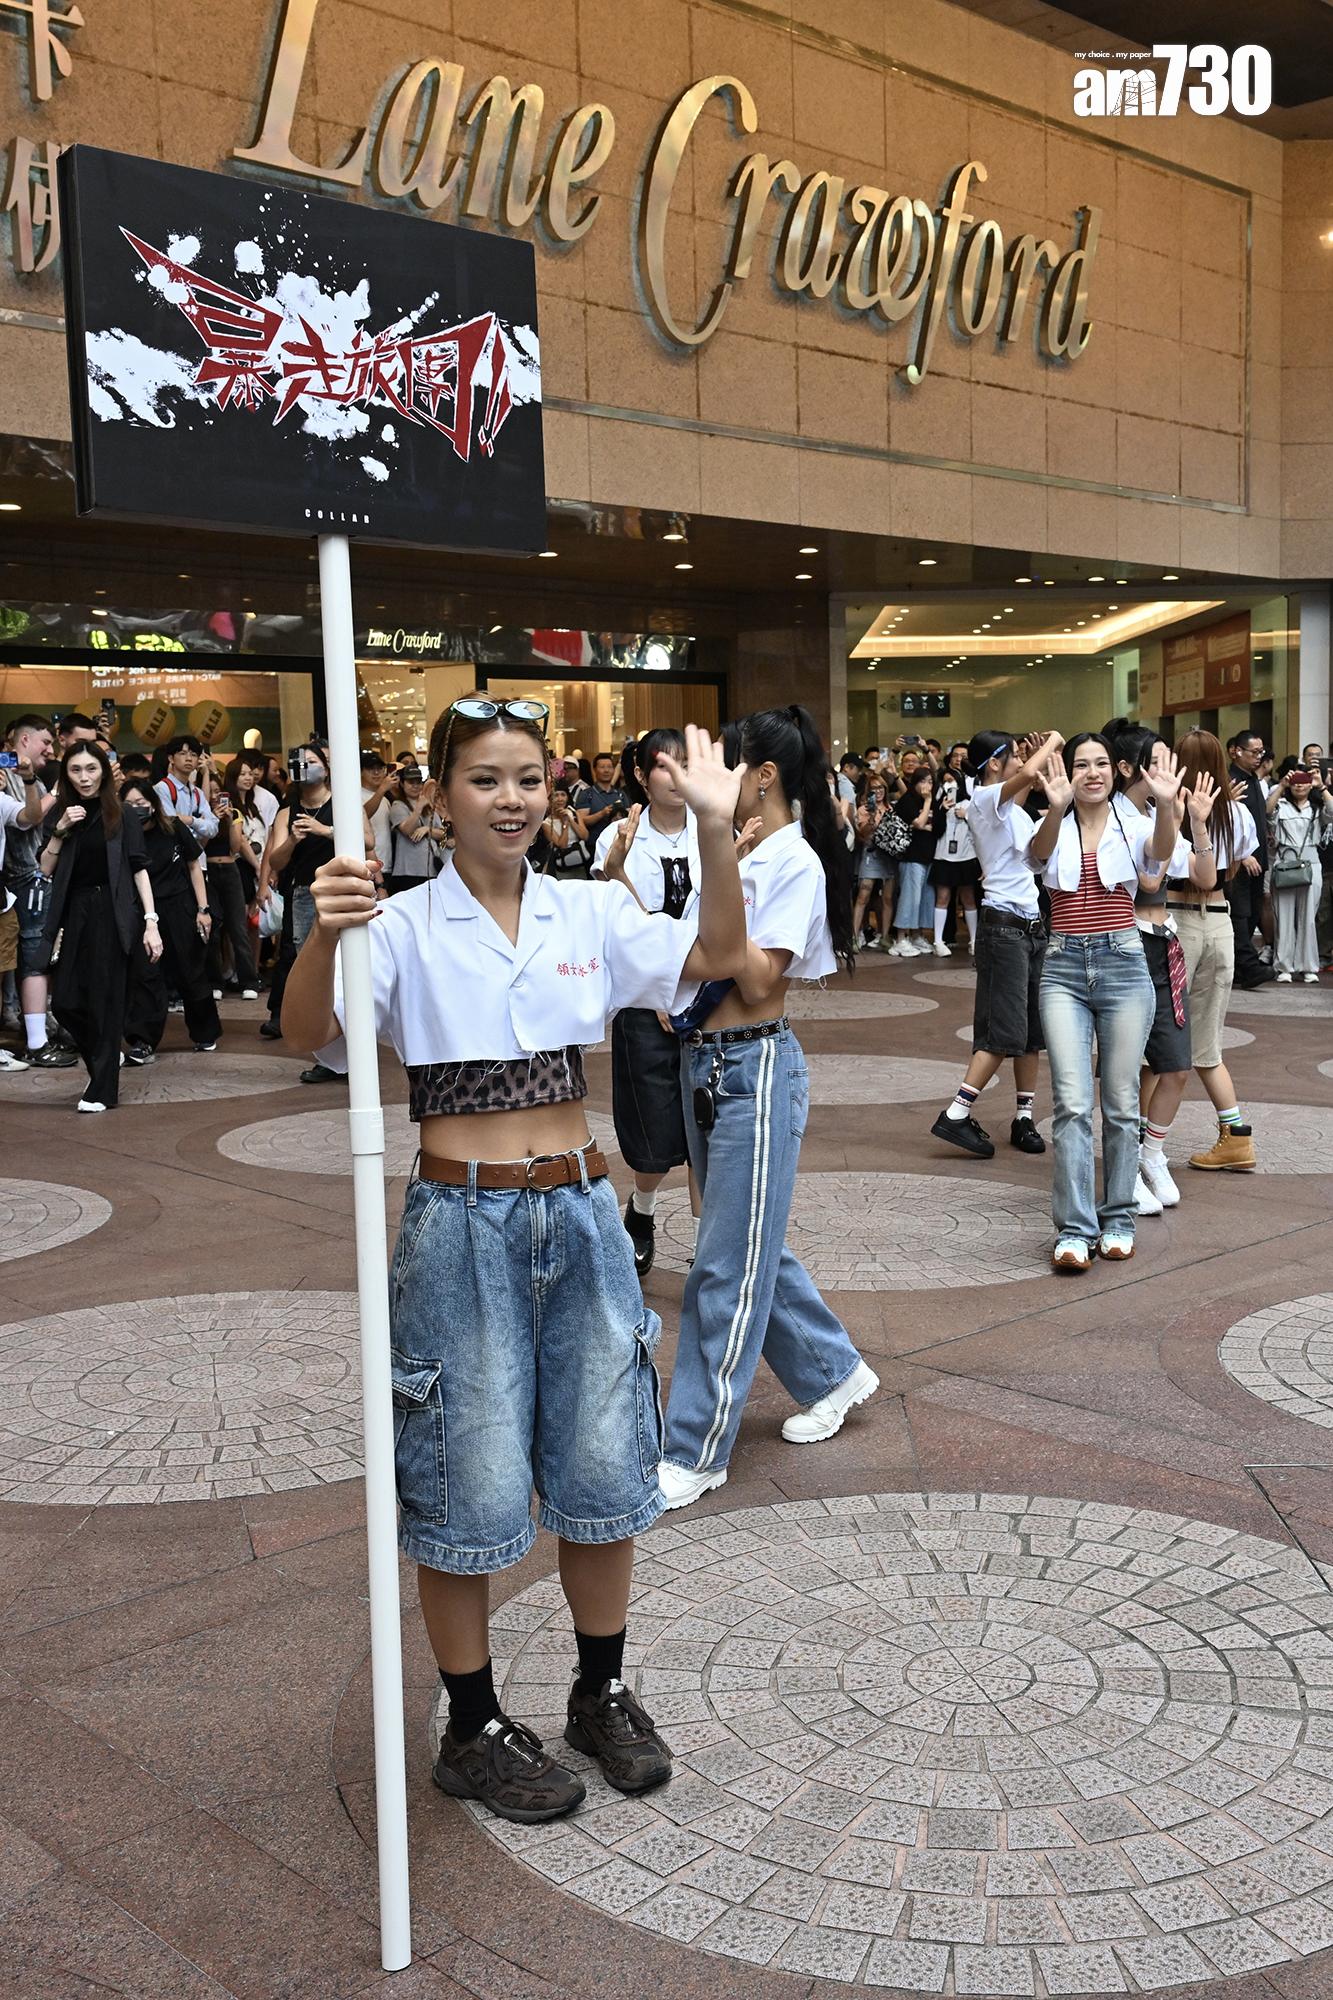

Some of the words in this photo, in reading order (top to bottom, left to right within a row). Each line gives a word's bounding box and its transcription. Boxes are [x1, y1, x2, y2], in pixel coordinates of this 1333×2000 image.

[233, 0, 616, 241] Lane
[638, 75, 1102, 385] Crawford
[305, 508, 370, 524] COLLAR
[367, 628, 392, 647] Lane
[393, 628, 442, 654] Crawford
[145, 707, 168, 739] SALE
[202, 709, 223, 738] SALE
